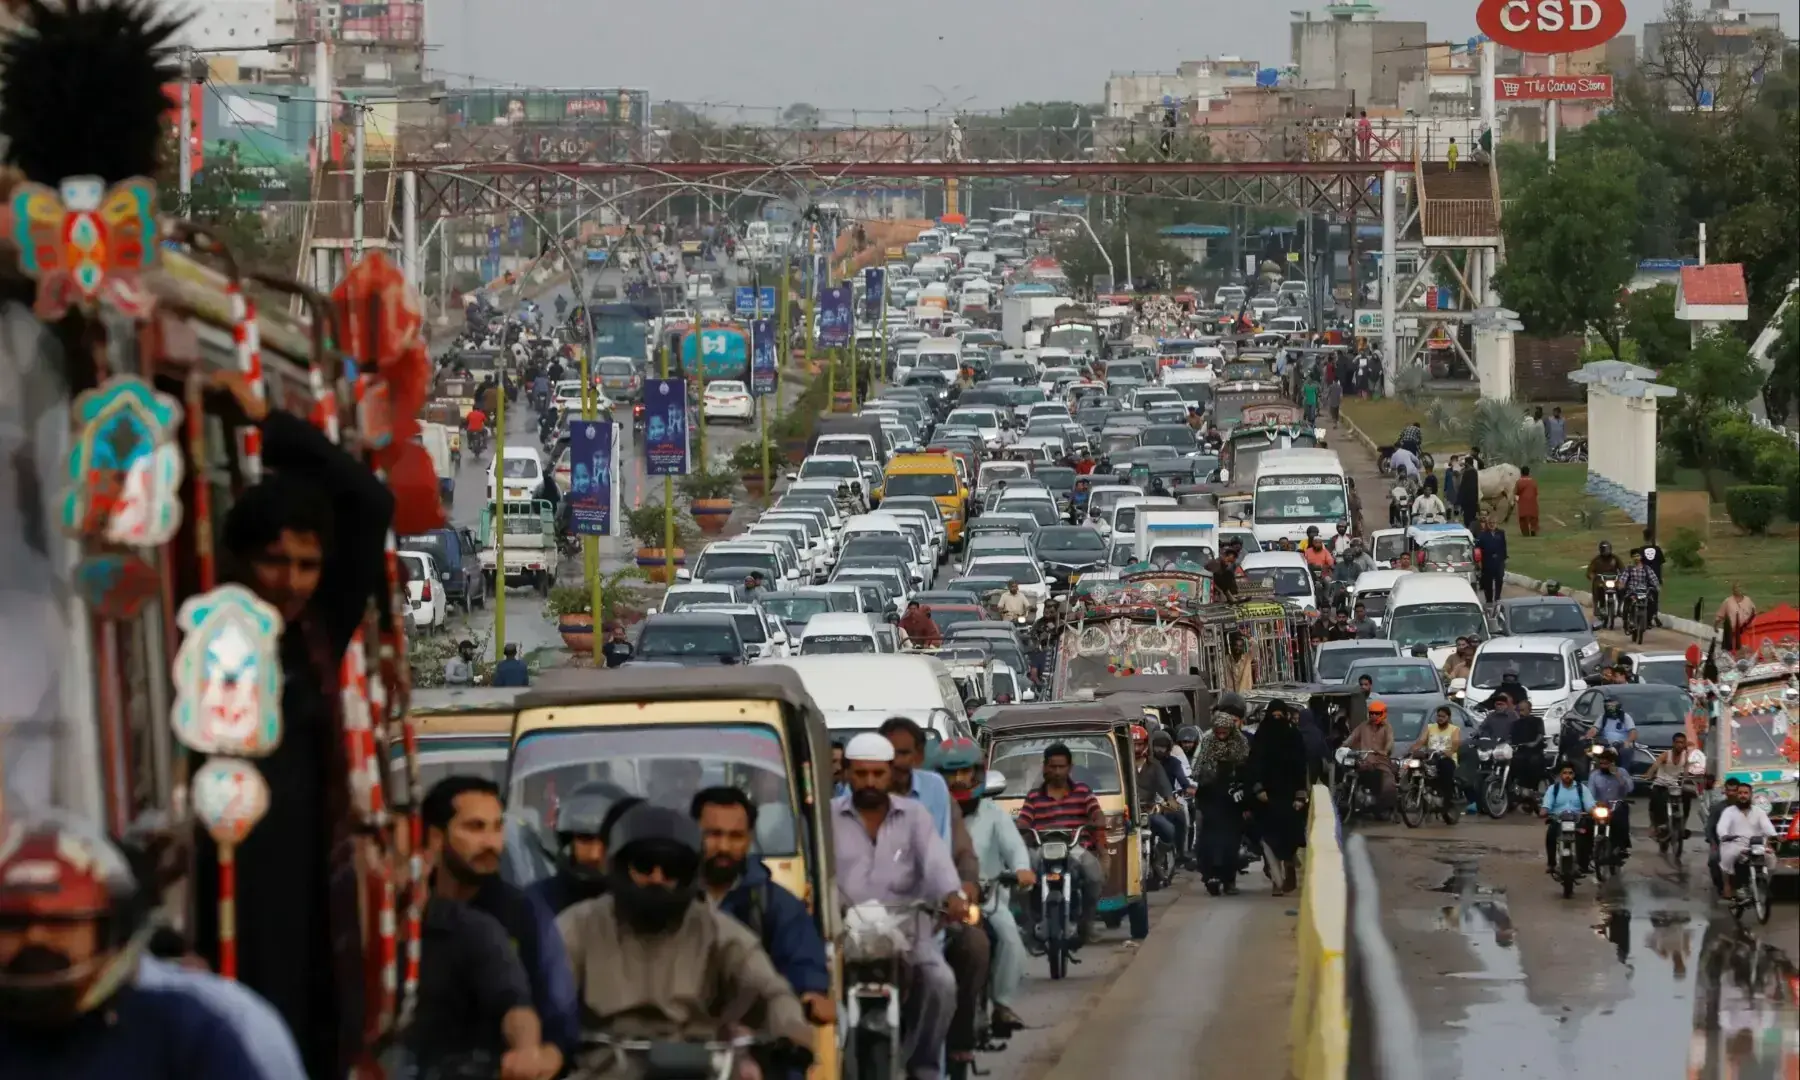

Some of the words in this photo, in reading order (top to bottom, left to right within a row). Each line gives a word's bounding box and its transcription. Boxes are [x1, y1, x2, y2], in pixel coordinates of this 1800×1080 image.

[1500, 0, 1602, 32] CSD
[1525, 79, 1545, 93] The
[1547, 79, 1577, 95] Caring
[1578, 78, 1606, 92] Store
